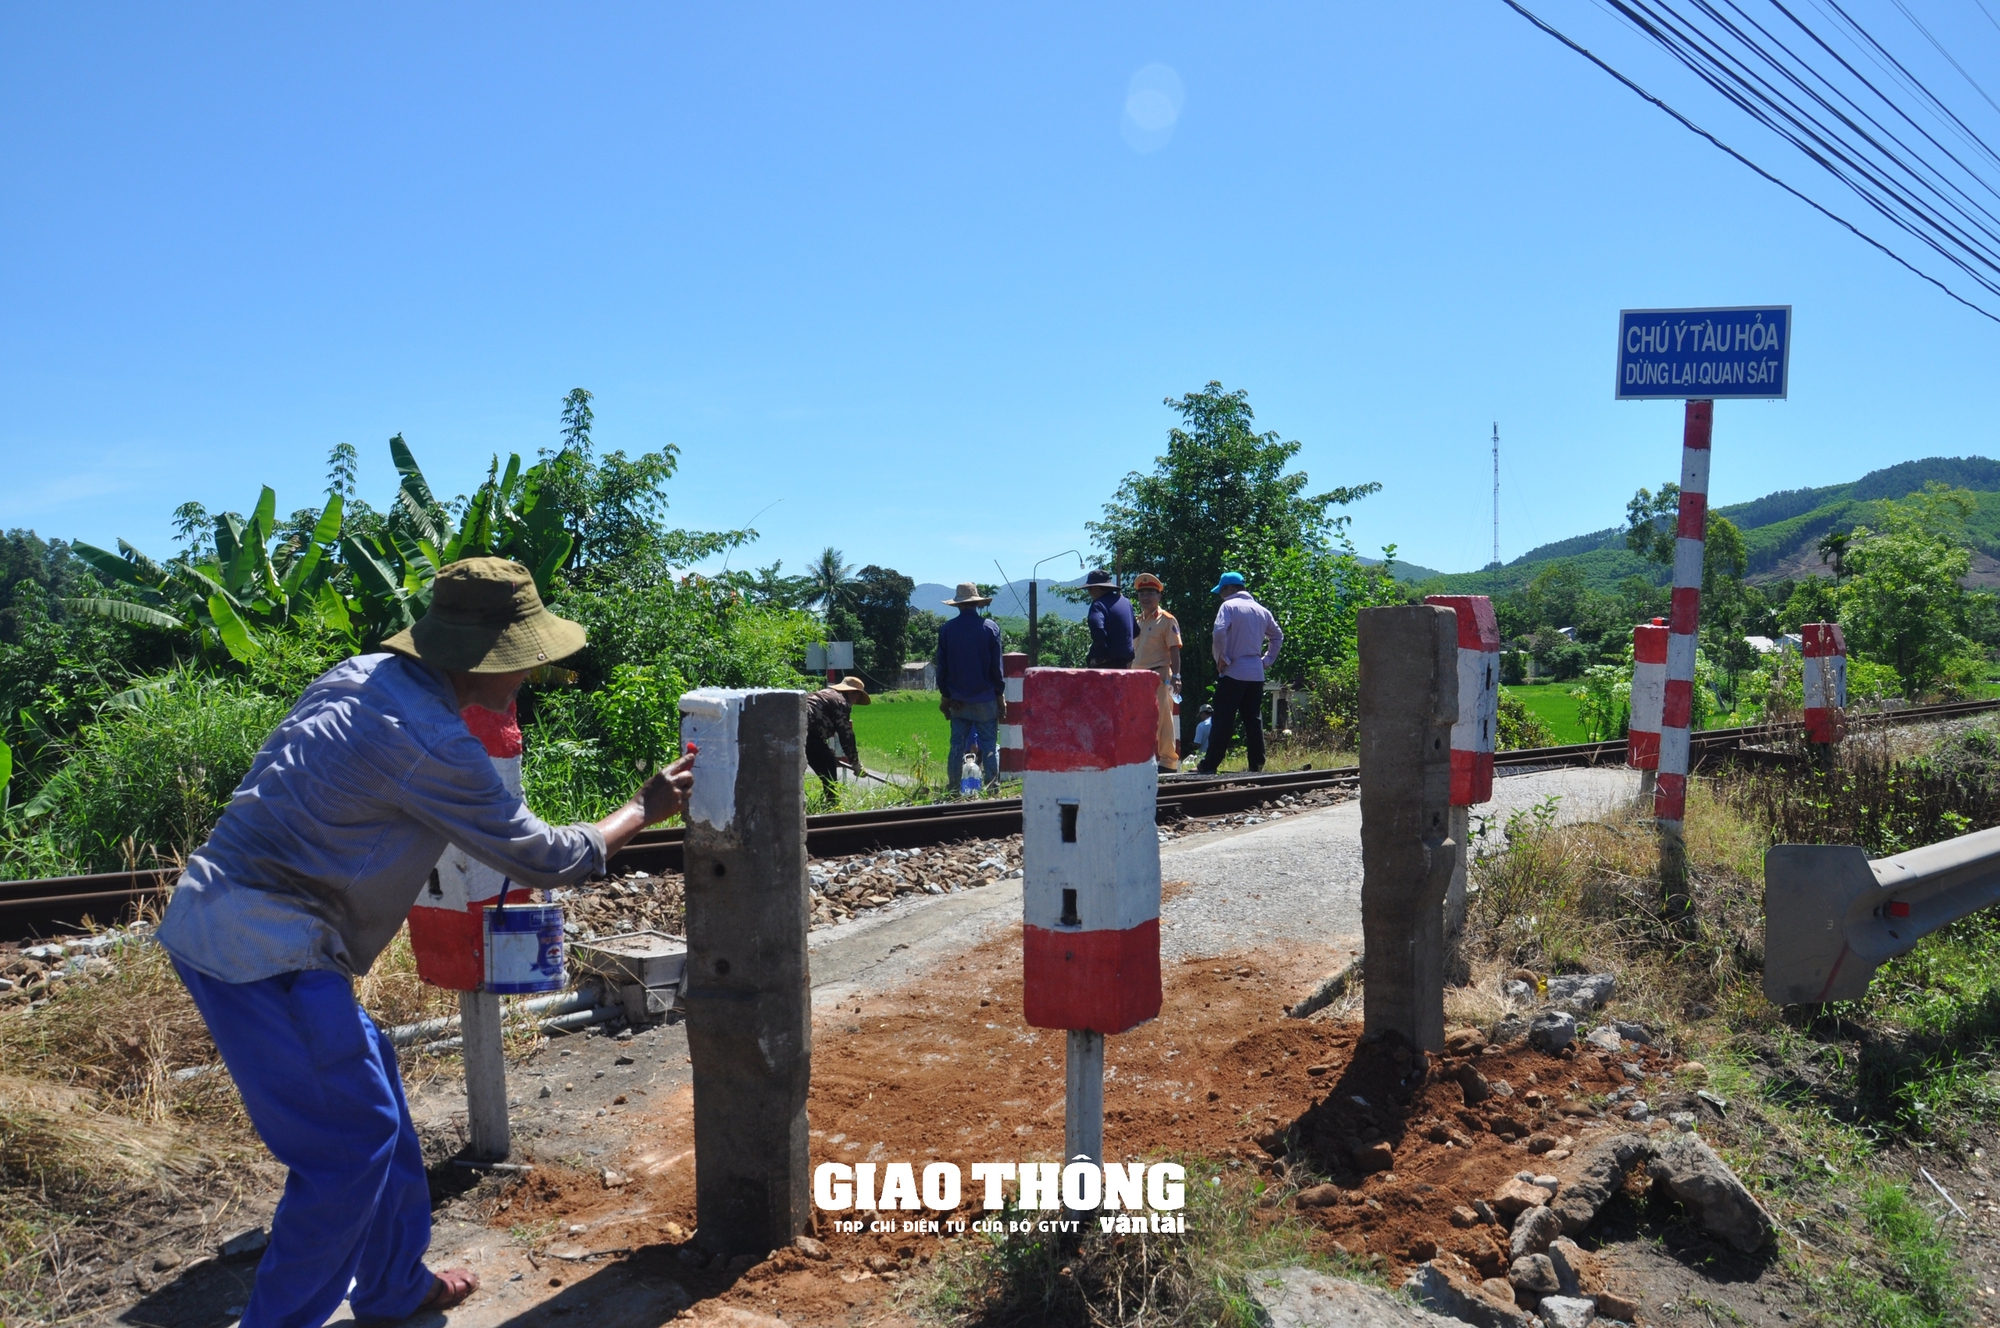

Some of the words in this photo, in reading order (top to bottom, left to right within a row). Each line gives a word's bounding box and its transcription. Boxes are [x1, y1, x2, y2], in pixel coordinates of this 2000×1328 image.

[1626, 320, 1670, 353] CHÚ
[1674, 320, 1688, 352] Ý
[1690, 319, 1731, 352] TÀU
[1734, 313, 1779, 351] HỎA
[1625, 358, 1669, 385] DỪNG
[1672, 362, 1696, 386] LẠI
[1699, 361, 1745, 385] QUAN
[1747, 356, 1778, 384] SÁT
